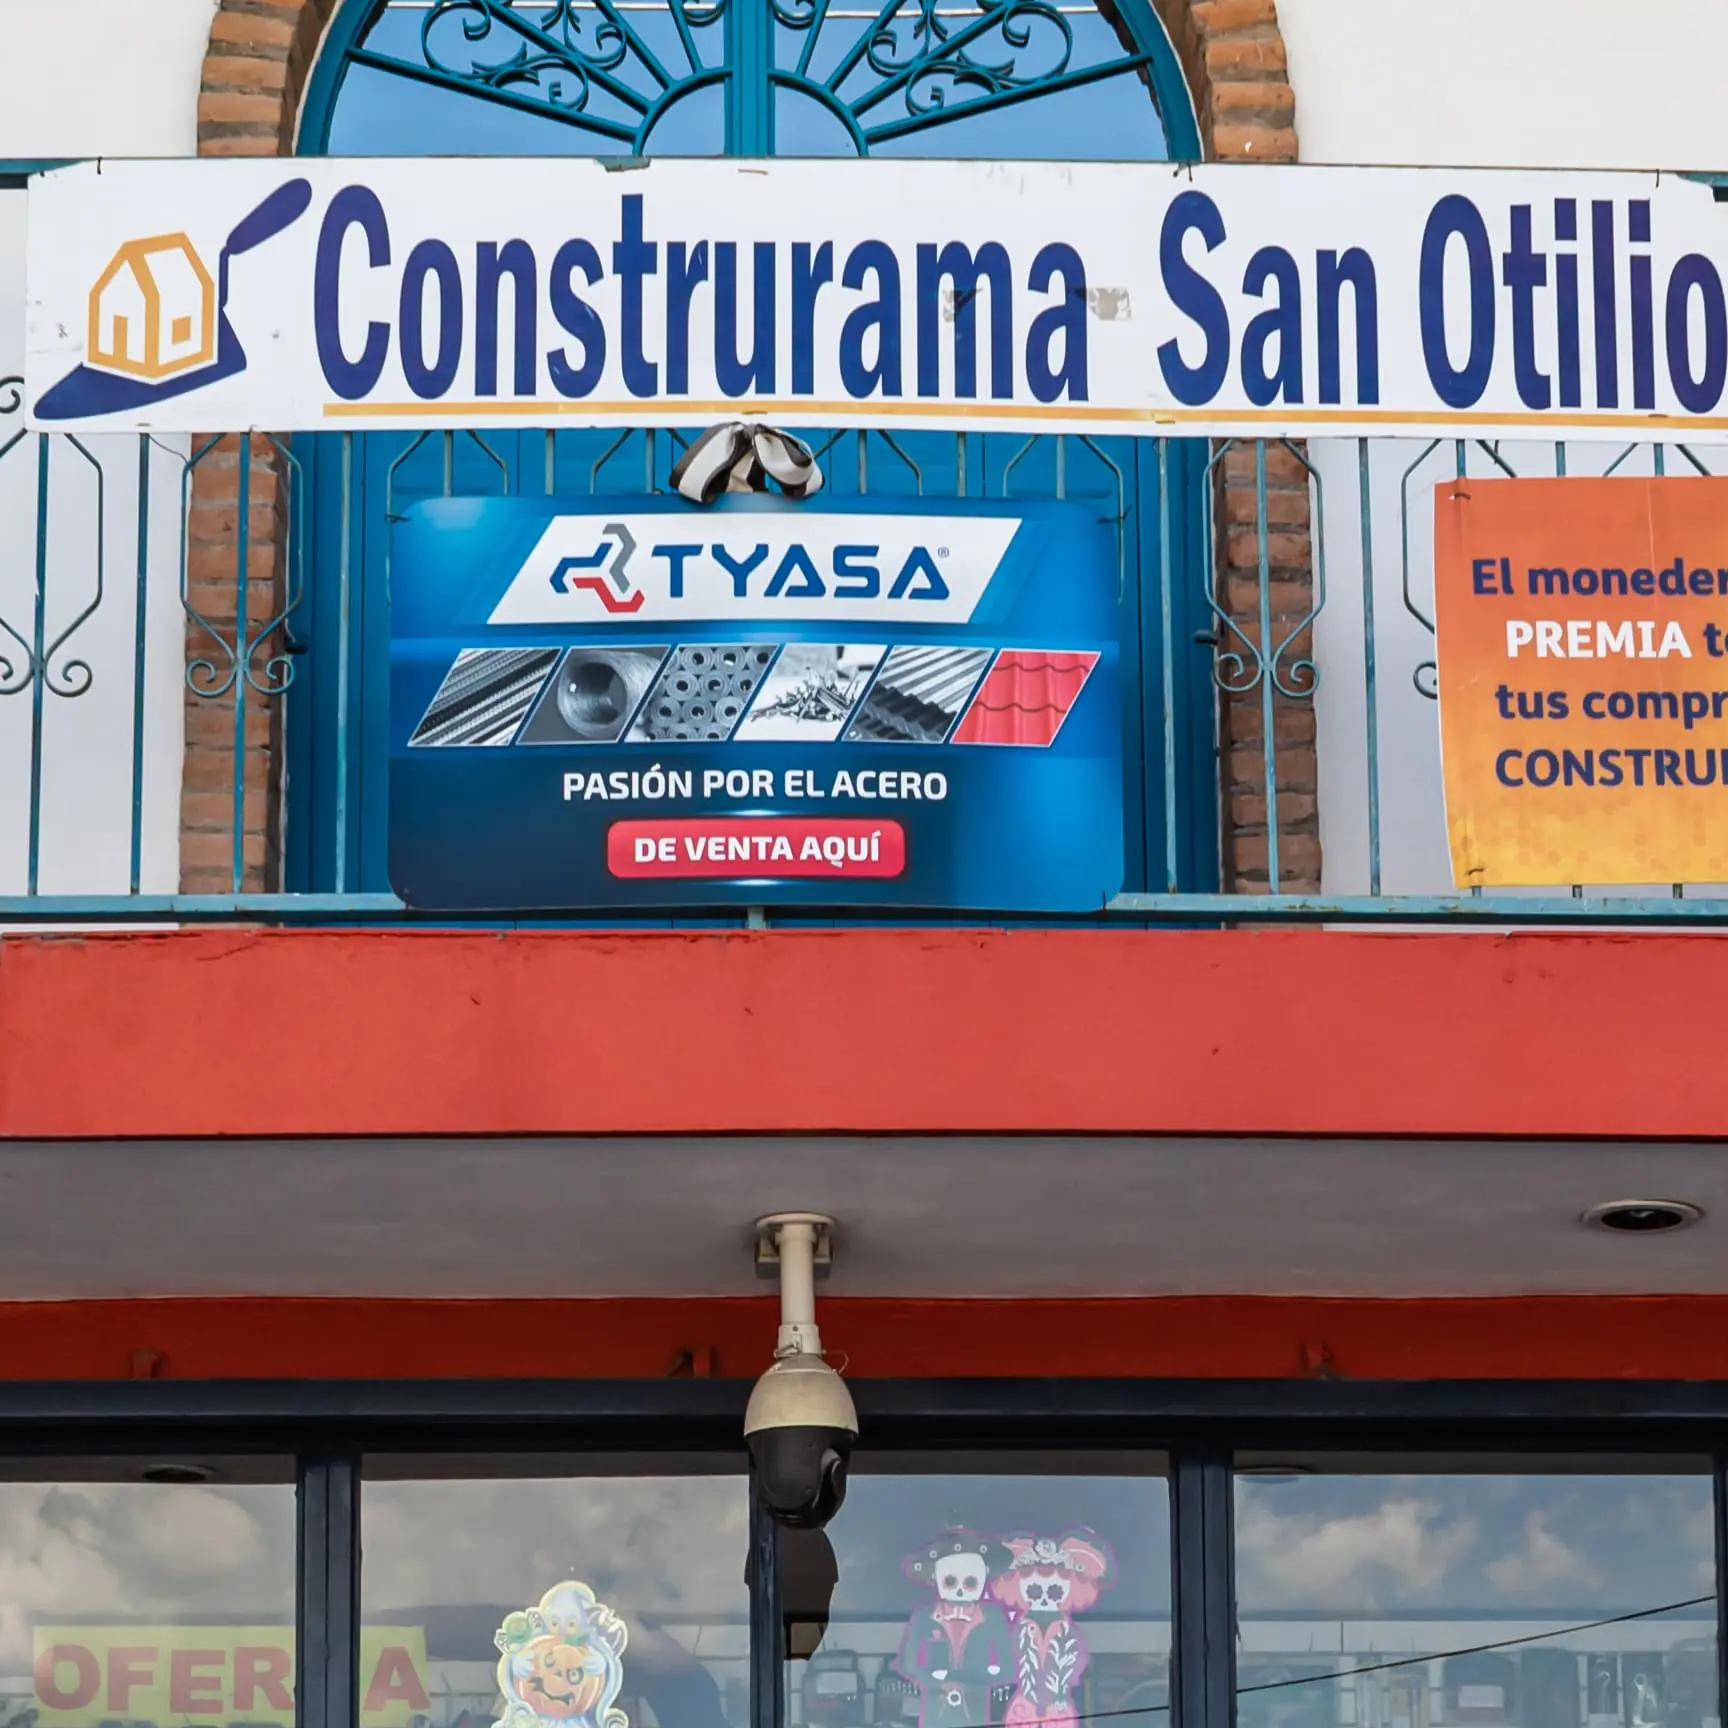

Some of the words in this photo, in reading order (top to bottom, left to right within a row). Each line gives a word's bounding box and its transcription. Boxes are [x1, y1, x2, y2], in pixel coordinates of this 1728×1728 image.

[314, 184, 1088, 403] Construrama
[1157, 190, 1379, 406] San
[1419, 194, 1727, 413] Otilio
[651, 544, 949, 600] TYASA
[1473, 558, 1514, 595] El
[1506, 620, 1692, 658] PREMIA
[1495, 684, 1569, 719] tus
[564, 764, 692, 800] PASIÓN
[704, 770, 774, 798] POR
[785, 771, 824, 797] EL
[832, 771, 947, 800] ACERO
[634, 837, 677, 861] DE
[685, 837, 793, 861] VENTA
[800, 831, 881, 867] AQUÍ
[34, 1644, 432, 1714] OFERA
